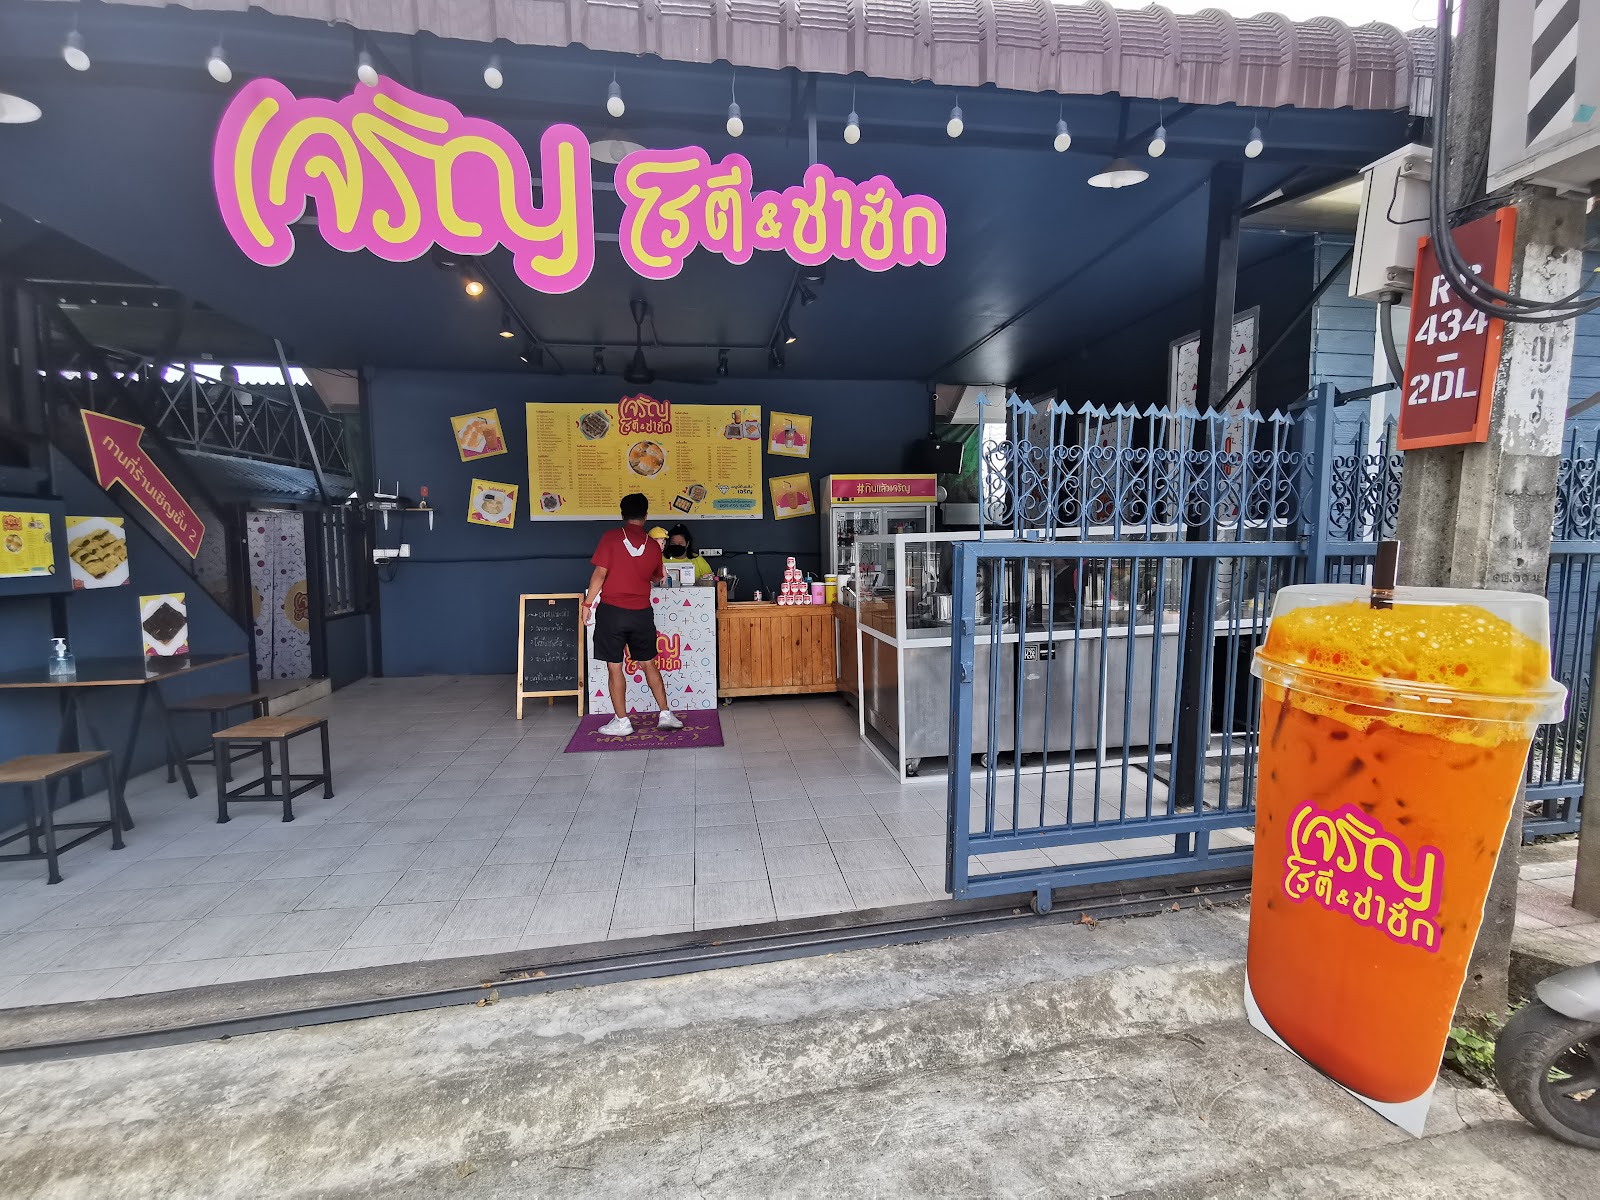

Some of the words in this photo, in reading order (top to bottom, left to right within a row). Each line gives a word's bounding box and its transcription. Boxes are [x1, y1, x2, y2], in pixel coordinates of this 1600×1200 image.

[233, 92, 579, 277] เจริญ
[1413, 309, 1488, 346] 434
[1408, 367, 1477, 406] 2DL
[596, 733, 670, 743] HAPPY
[1291, 805, 1435, 912] เจริญ
